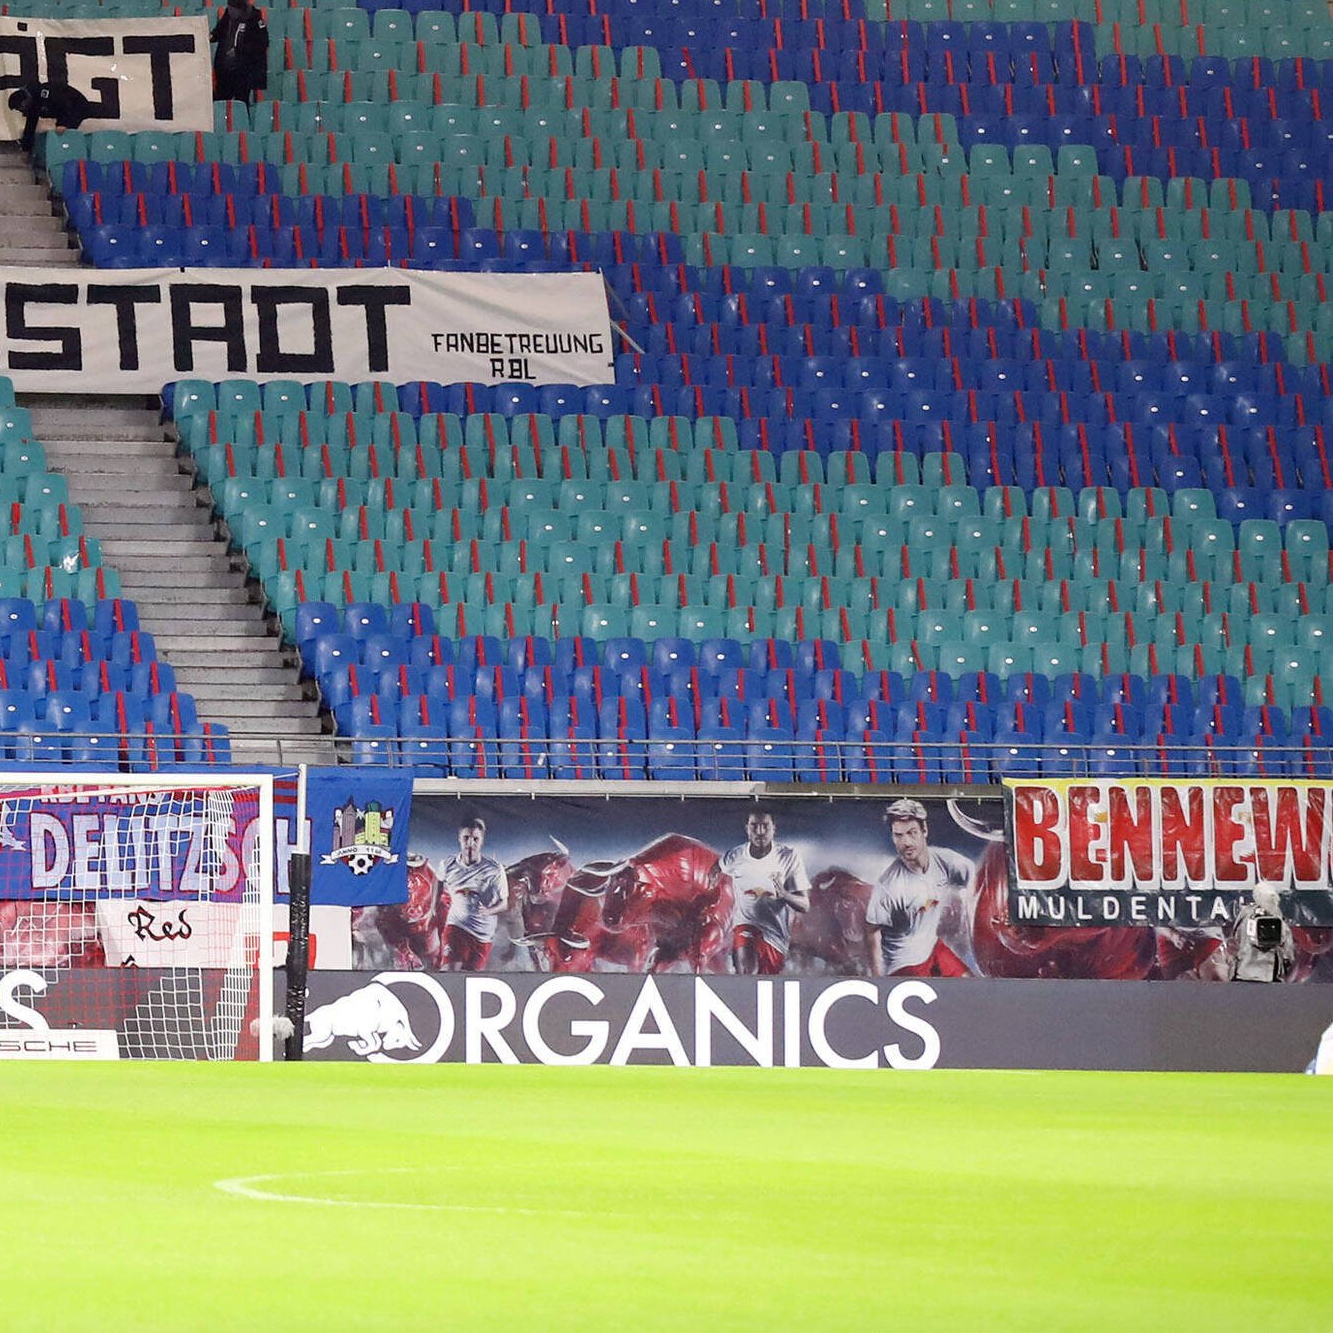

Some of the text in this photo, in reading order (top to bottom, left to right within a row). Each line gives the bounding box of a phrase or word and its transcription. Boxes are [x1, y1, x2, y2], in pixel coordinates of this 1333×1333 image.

[431, 332, 604, 355] FANBETREUUNG
[490, 357, 537, 380] RBL
[1014, 784, 1333, 889] BENNEW
[127, 906, 193, 942] Red
[367, 970, 942, 1071] ORGANICS
